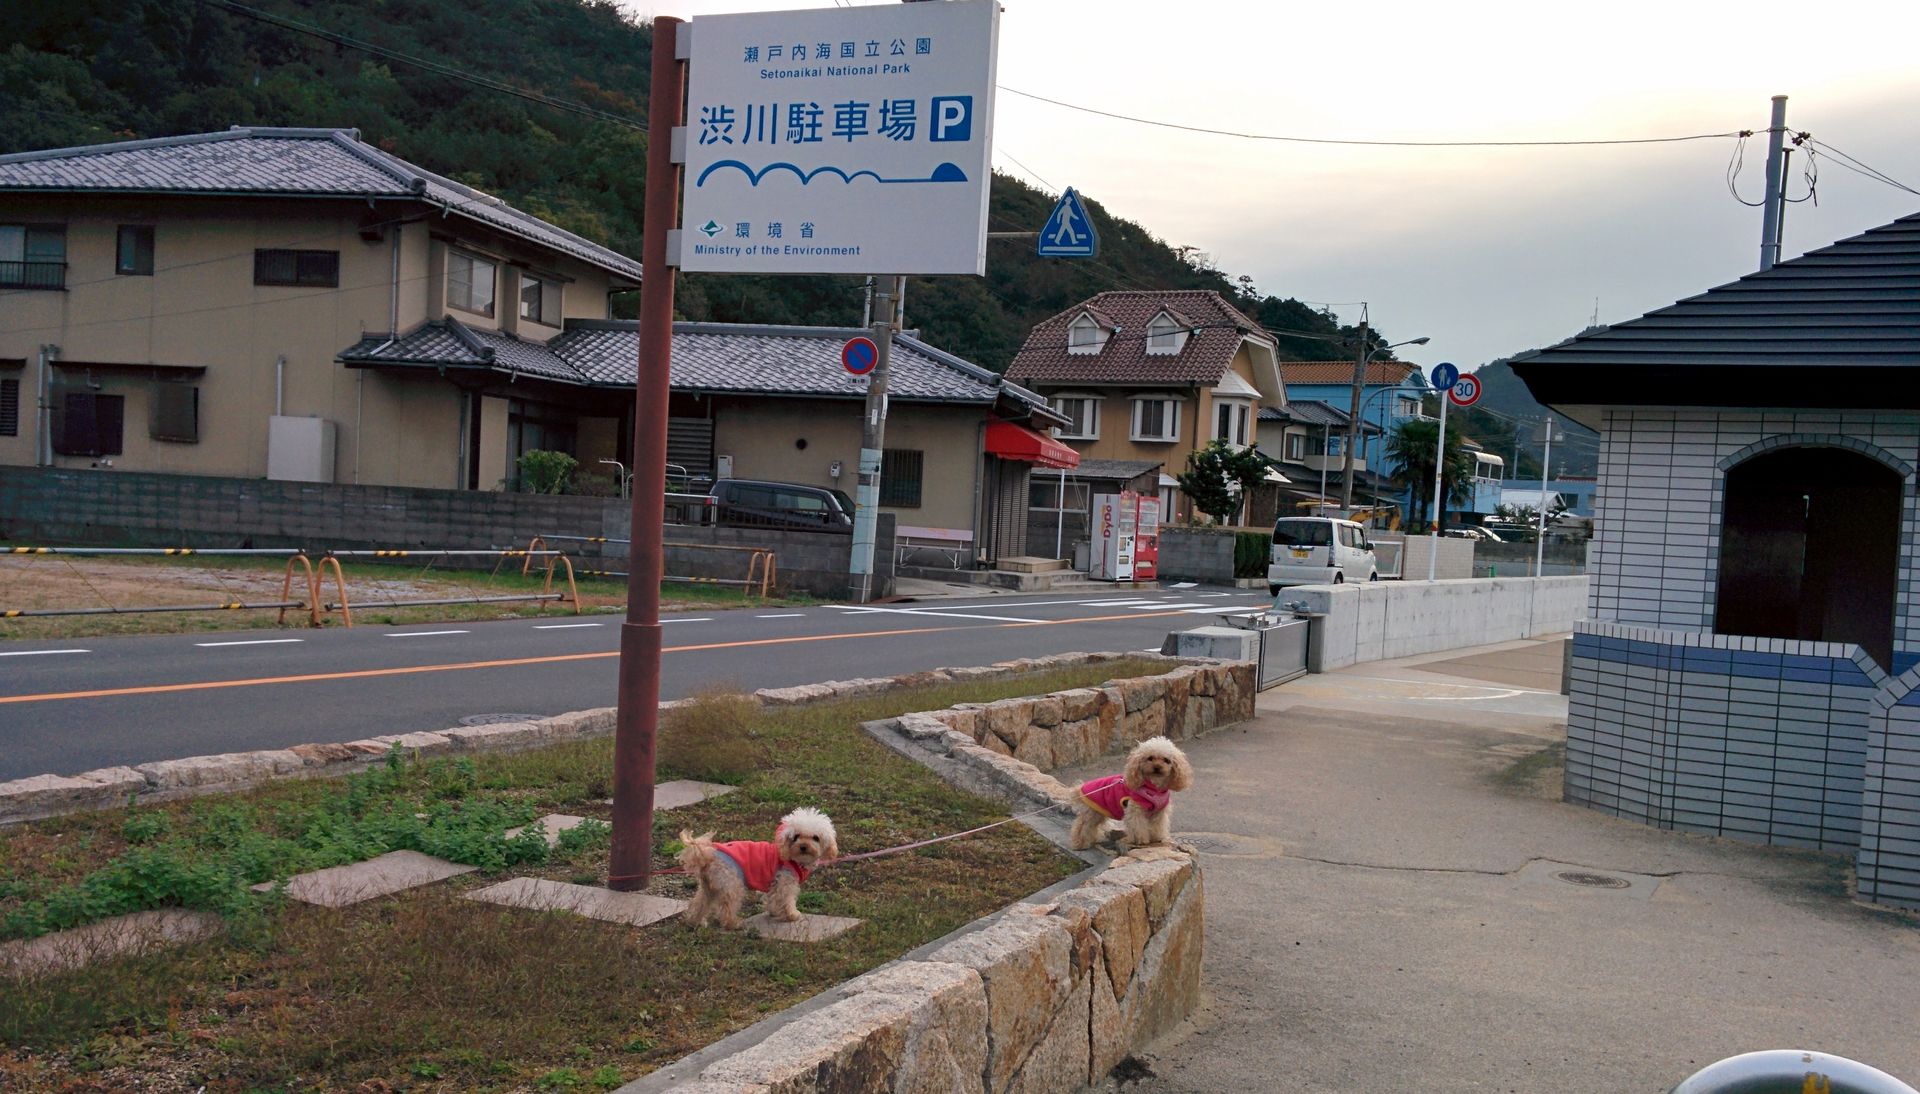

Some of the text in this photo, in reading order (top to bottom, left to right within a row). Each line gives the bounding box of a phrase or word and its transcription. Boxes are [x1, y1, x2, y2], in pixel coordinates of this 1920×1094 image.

[743, 37, 932, 63] 瀬戸内海国立公園
[759, 63, 911, 80] Setonaikai National Park
[698, 98, 917, 145] 渋川駐車場
[937, 100, 966, 139] P
[735, 222, 815, 239] 環境省
[695, 244, 861, 256] Ministry of the Environment
[1455, 382, 1473, 396] 30
[1103, 504, 1114, 538] DyDo
